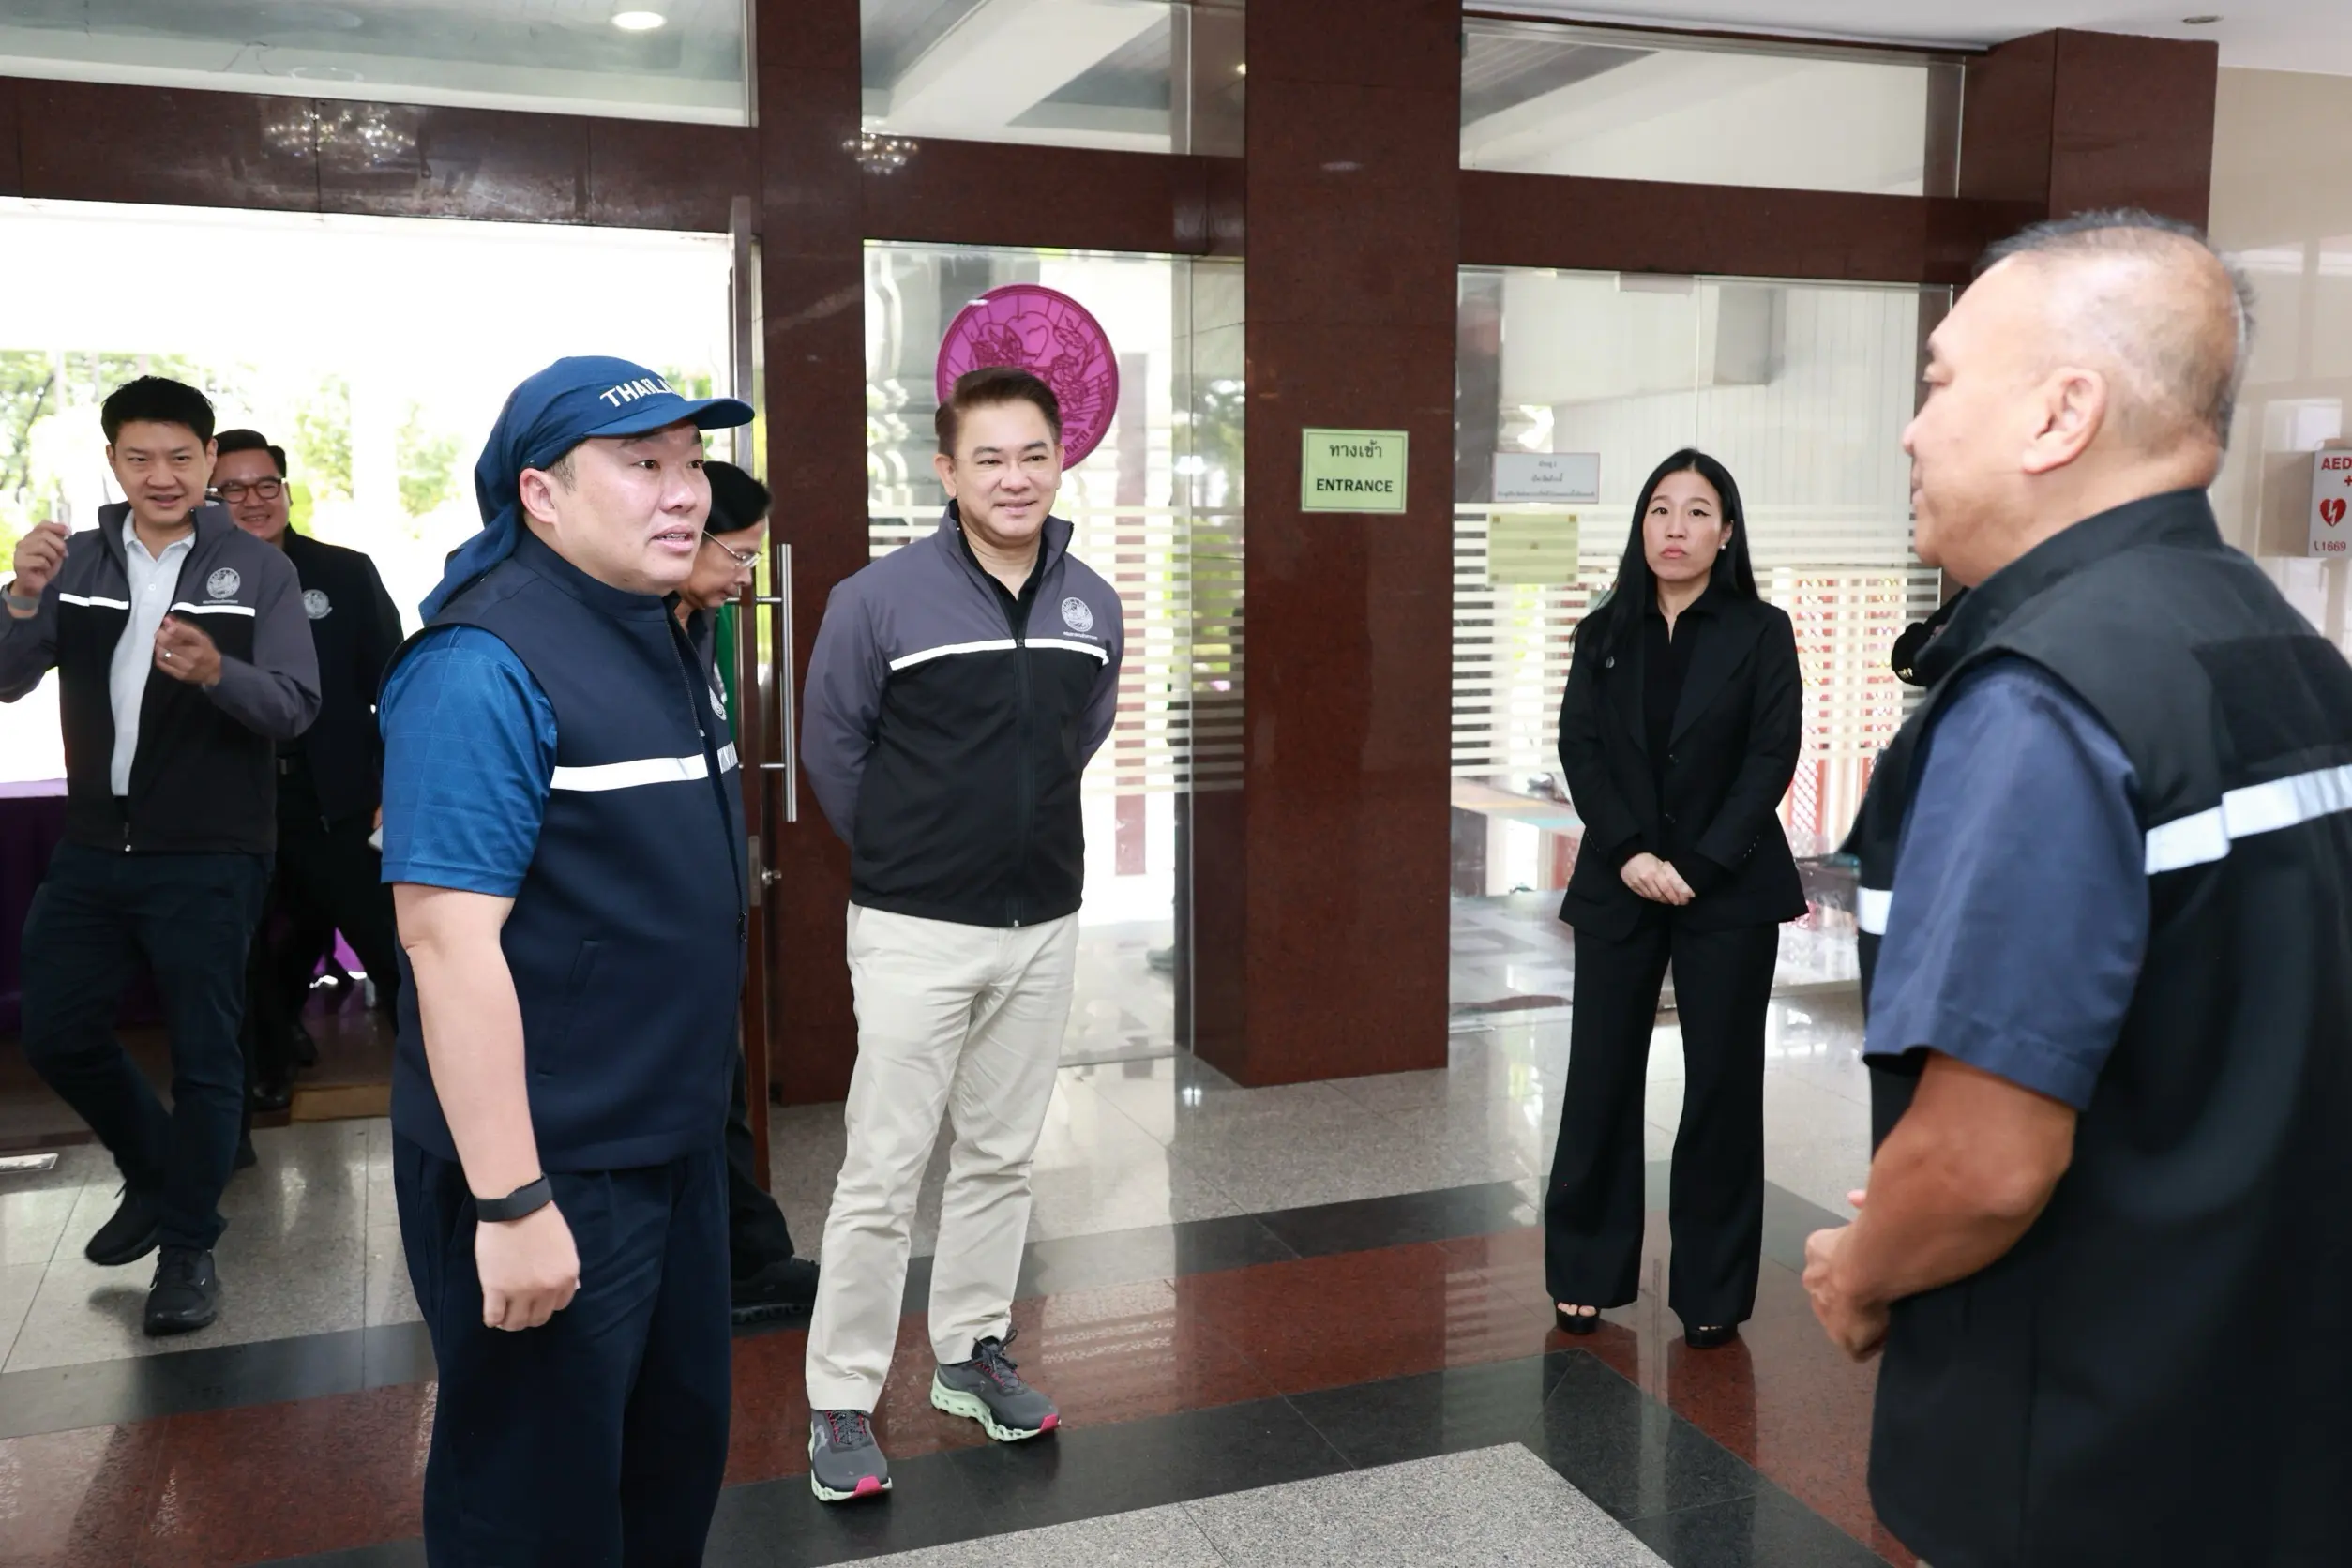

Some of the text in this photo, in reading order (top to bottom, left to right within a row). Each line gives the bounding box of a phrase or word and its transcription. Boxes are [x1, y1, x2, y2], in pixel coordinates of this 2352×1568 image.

[1329, 439, 1382, 458] ทางเข้า
[2321, 457, 2352, 470] AED
[1316, 478, 1394, 492] ENTRANCE
[2322, 541, 2346, 551] 1669
